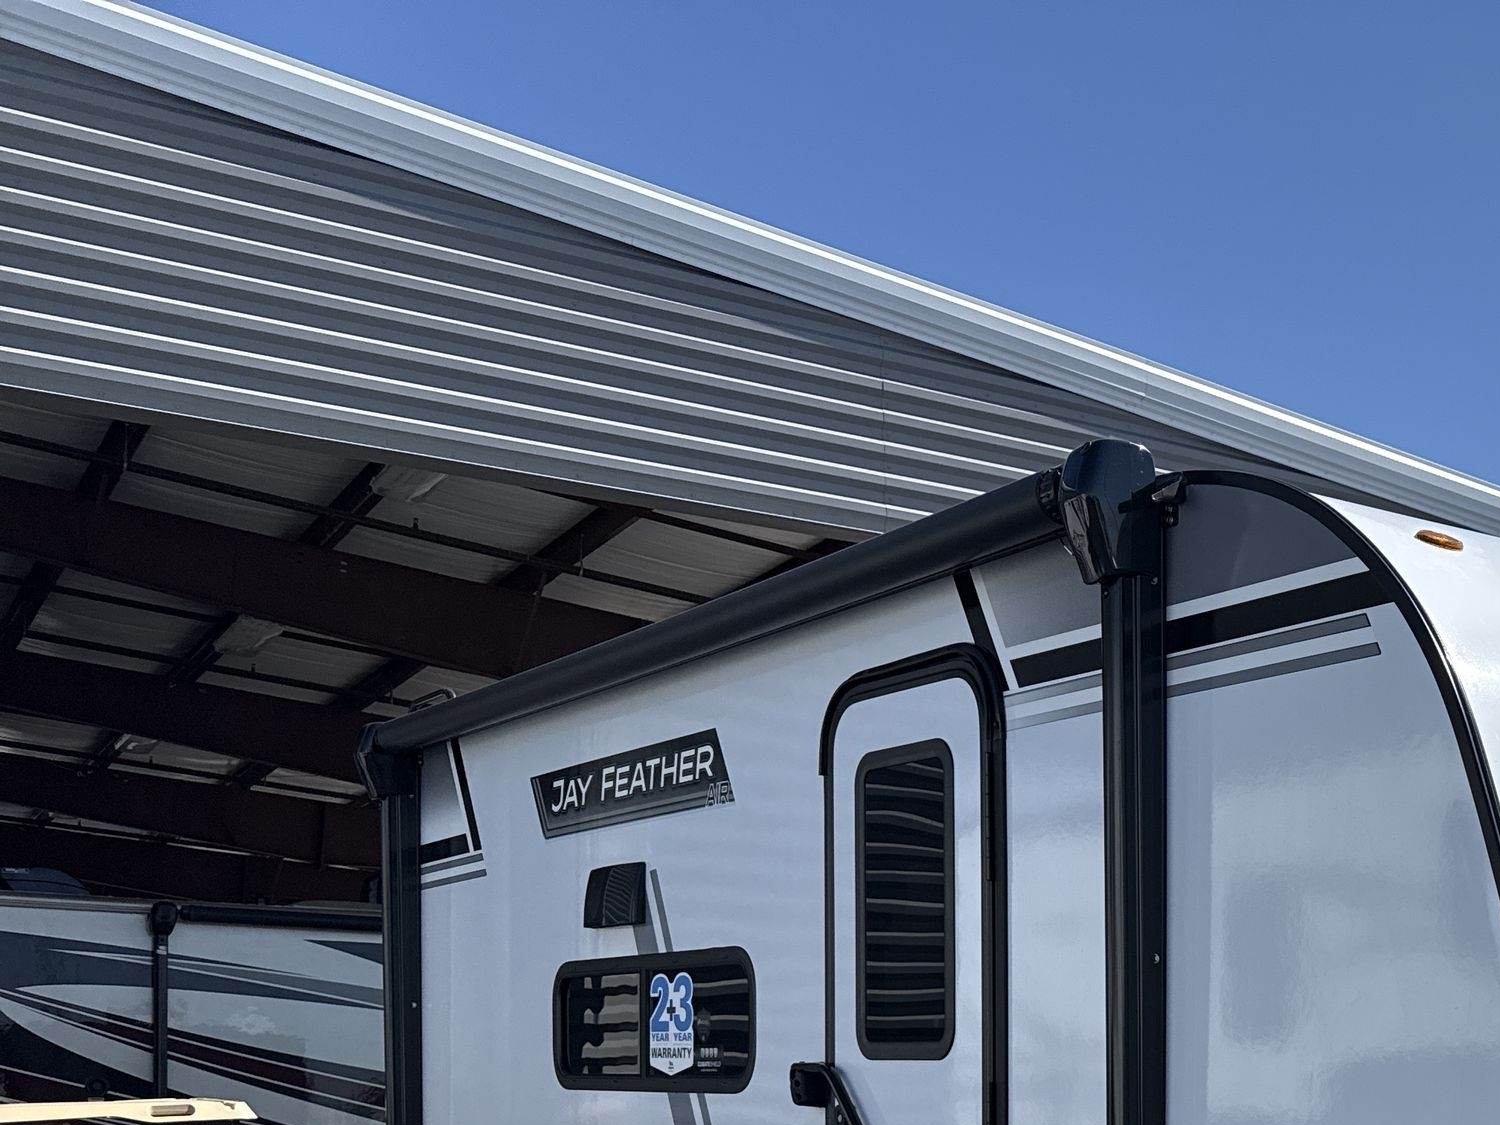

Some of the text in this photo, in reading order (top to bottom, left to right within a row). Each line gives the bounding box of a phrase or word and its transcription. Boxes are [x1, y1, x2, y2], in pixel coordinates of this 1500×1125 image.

[551, 744, 714, 813] JAY FEATHER
[705, 780, 730, 806] AIR
[651, 1032, 692, 1042] YEAR YEAR
[651, 1047, 692, 1059] WARRANTY
